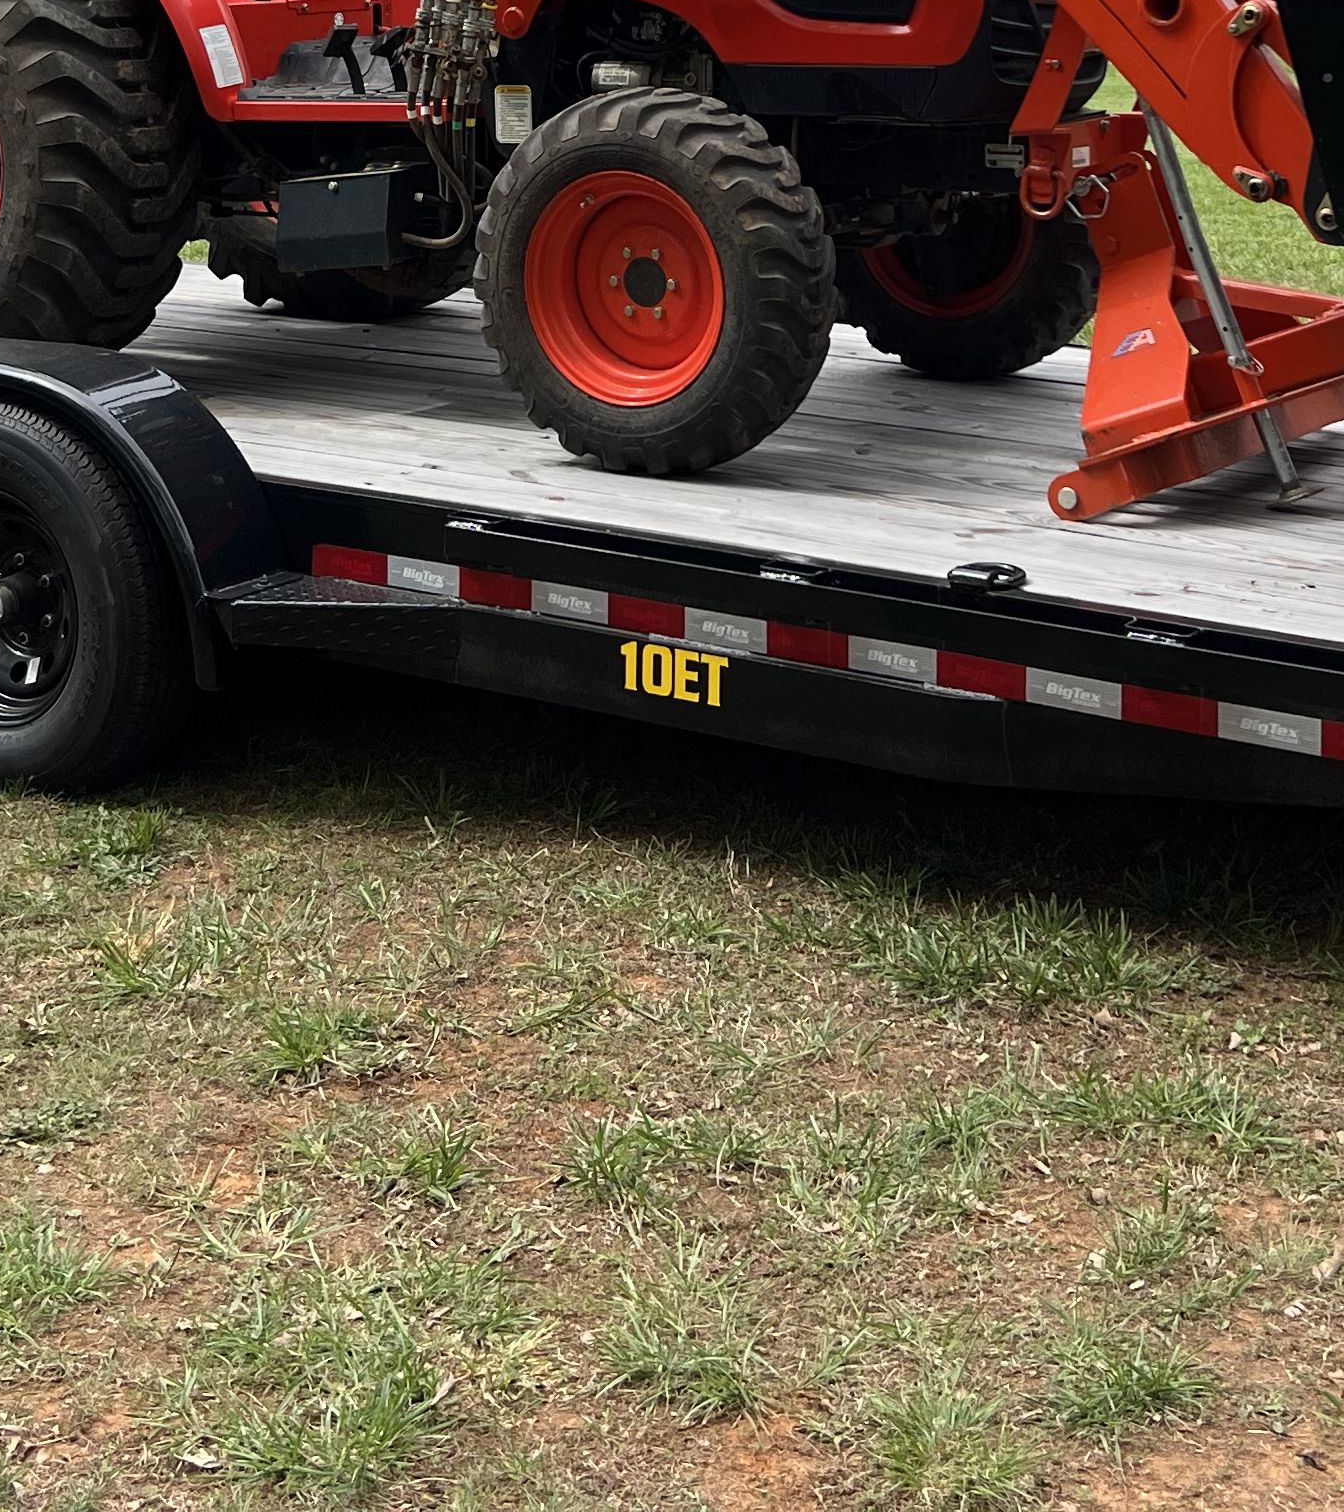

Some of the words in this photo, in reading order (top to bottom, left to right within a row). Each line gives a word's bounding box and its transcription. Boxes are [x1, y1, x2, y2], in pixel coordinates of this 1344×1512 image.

[402, 567, 445, 585] BigTex
[547, 592, 592, 610] BigTex
[702, 620, 750, 639] BigTex
[867, 648, 918, 669] BigTex
[620, 641, 730, 707] 10ET
[1046, 682, 1102, 703] BigTex
[1239, 717, 1299, 739] BigTex
